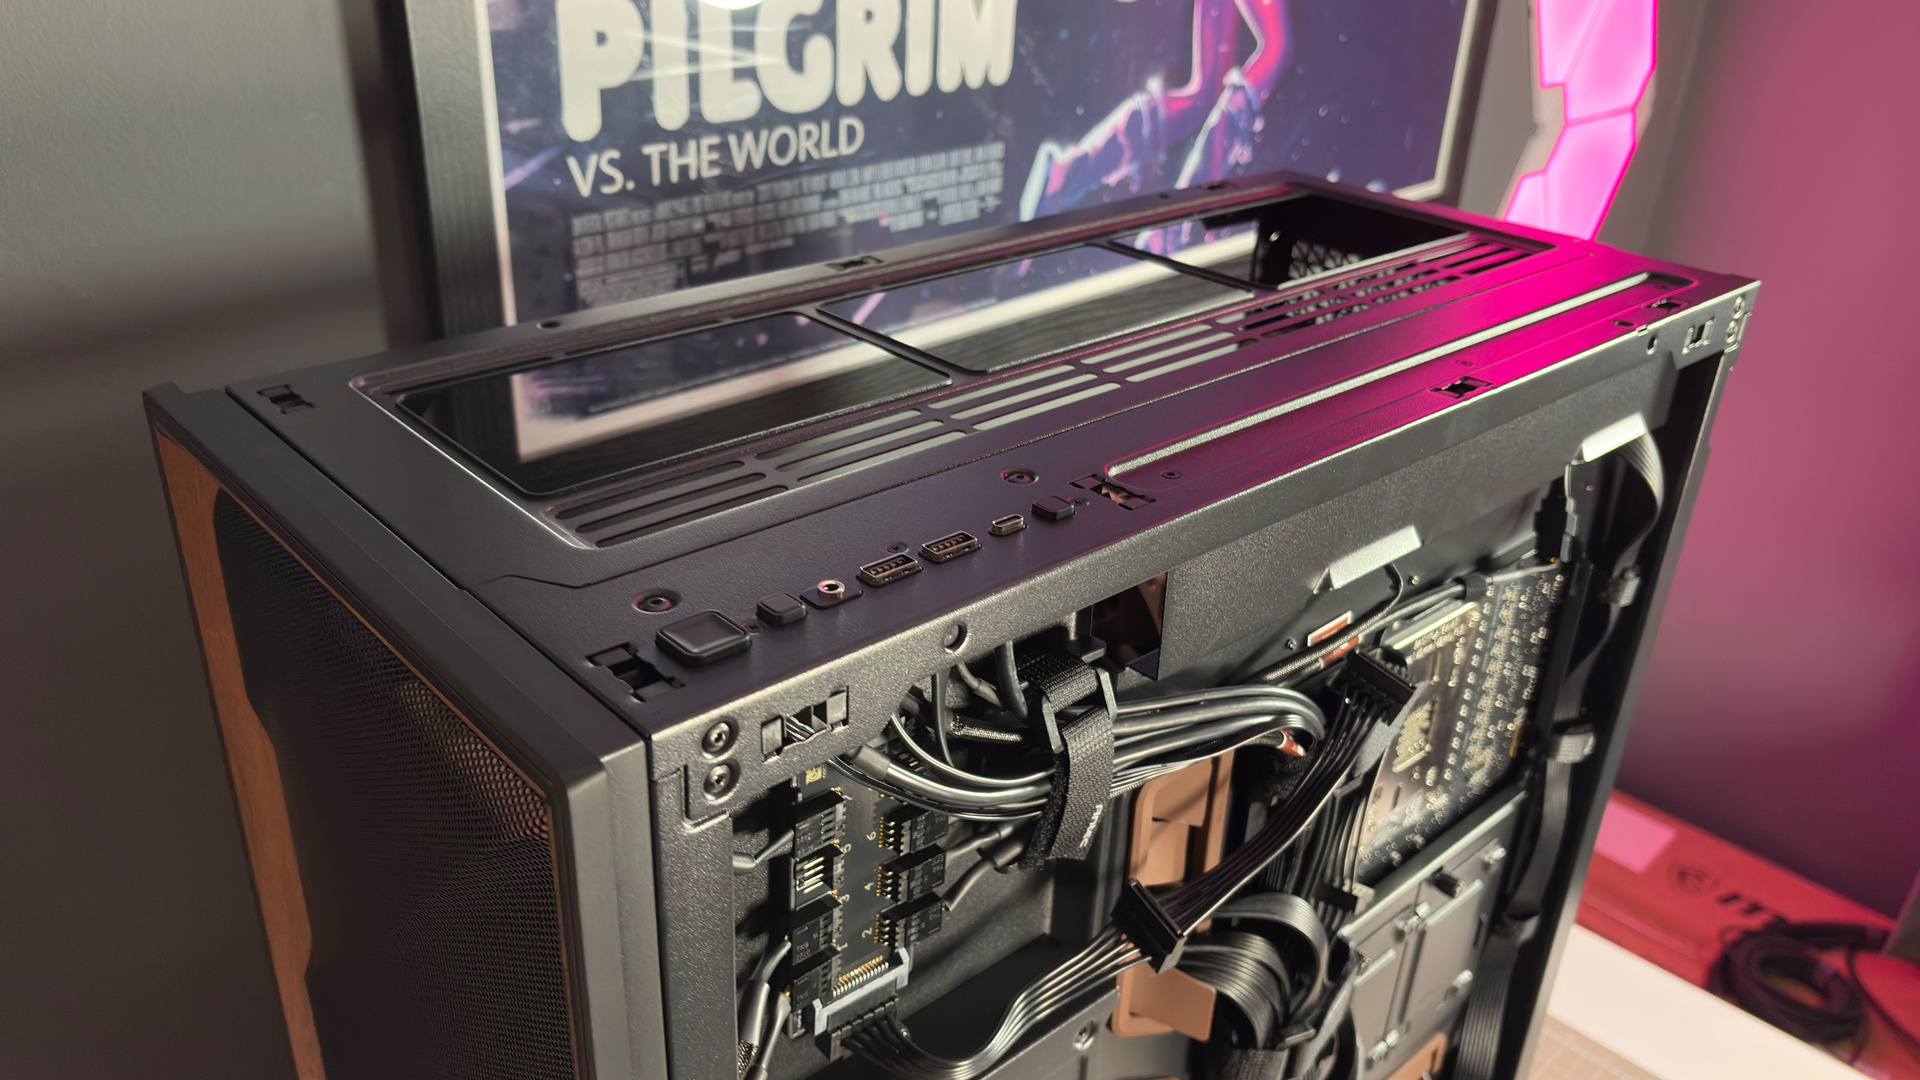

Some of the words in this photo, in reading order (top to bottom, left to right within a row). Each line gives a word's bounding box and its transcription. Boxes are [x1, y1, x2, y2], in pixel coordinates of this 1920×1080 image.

[556, 0, 1017, 142] PILGRIM
[568, 149, 634, 198] VS.
[642, 135, 723, 187] THE
[730, 116, 865, 173] WORLD
[866, 831, 877, 841] 6
[864, 881, 875, 891] 4
[861, 927, 873, 939] 2
